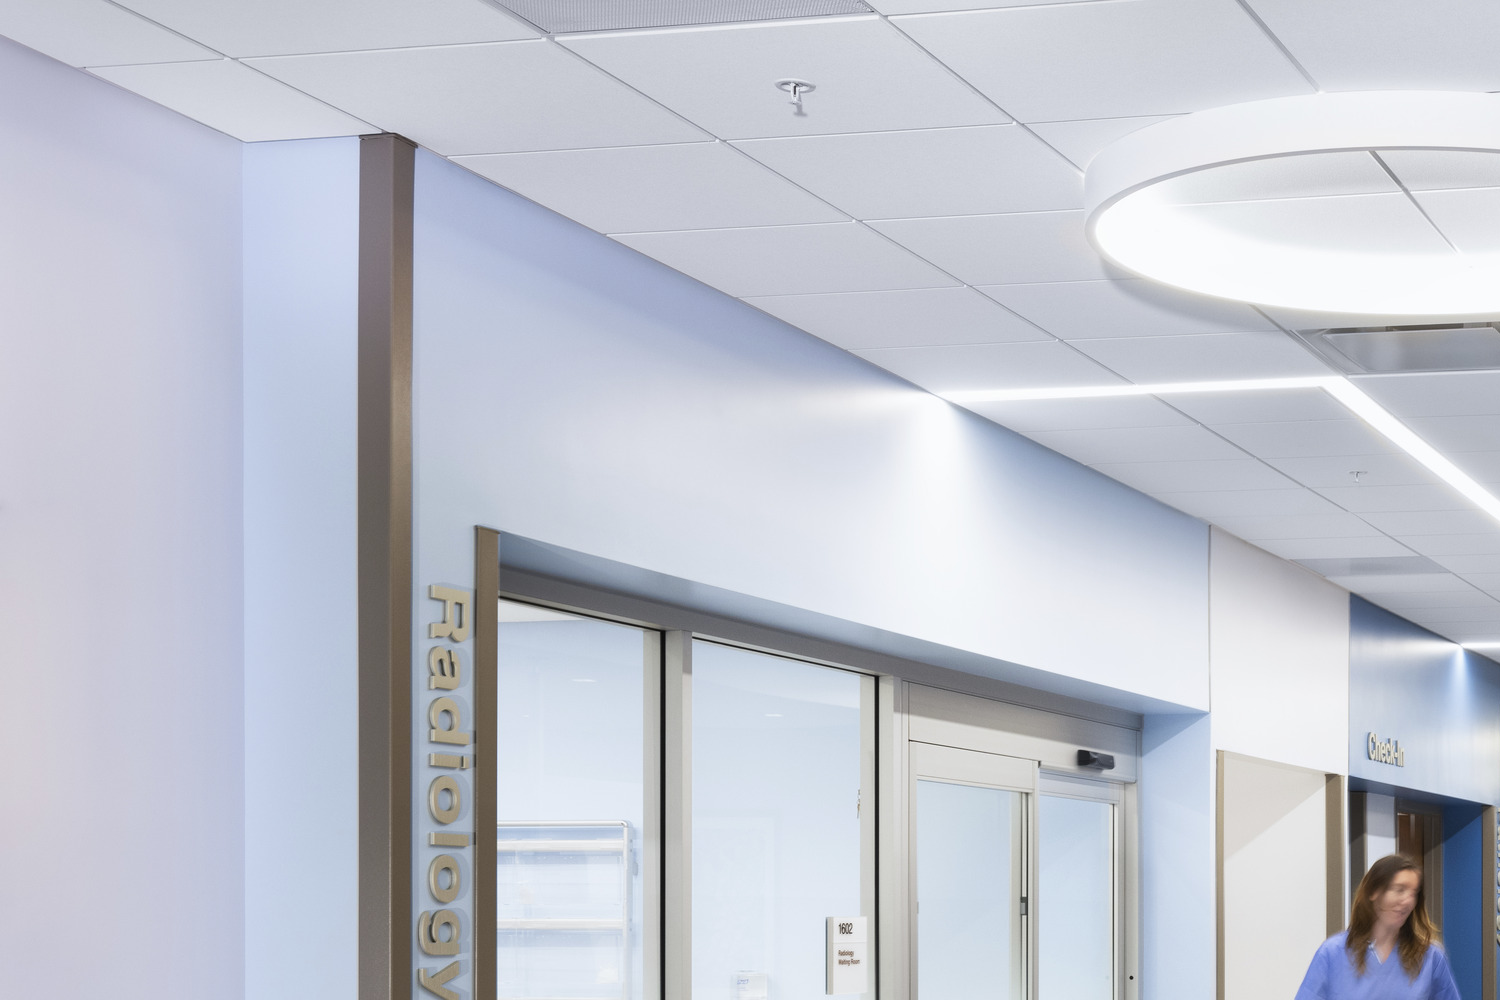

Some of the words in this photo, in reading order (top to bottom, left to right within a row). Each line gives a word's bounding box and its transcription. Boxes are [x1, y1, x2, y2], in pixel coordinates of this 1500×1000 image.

[1367, 732, 1404, 767] Check-In
[838, 922, 853, 935] 1602
[838, 949, 854, 957] Radiology
